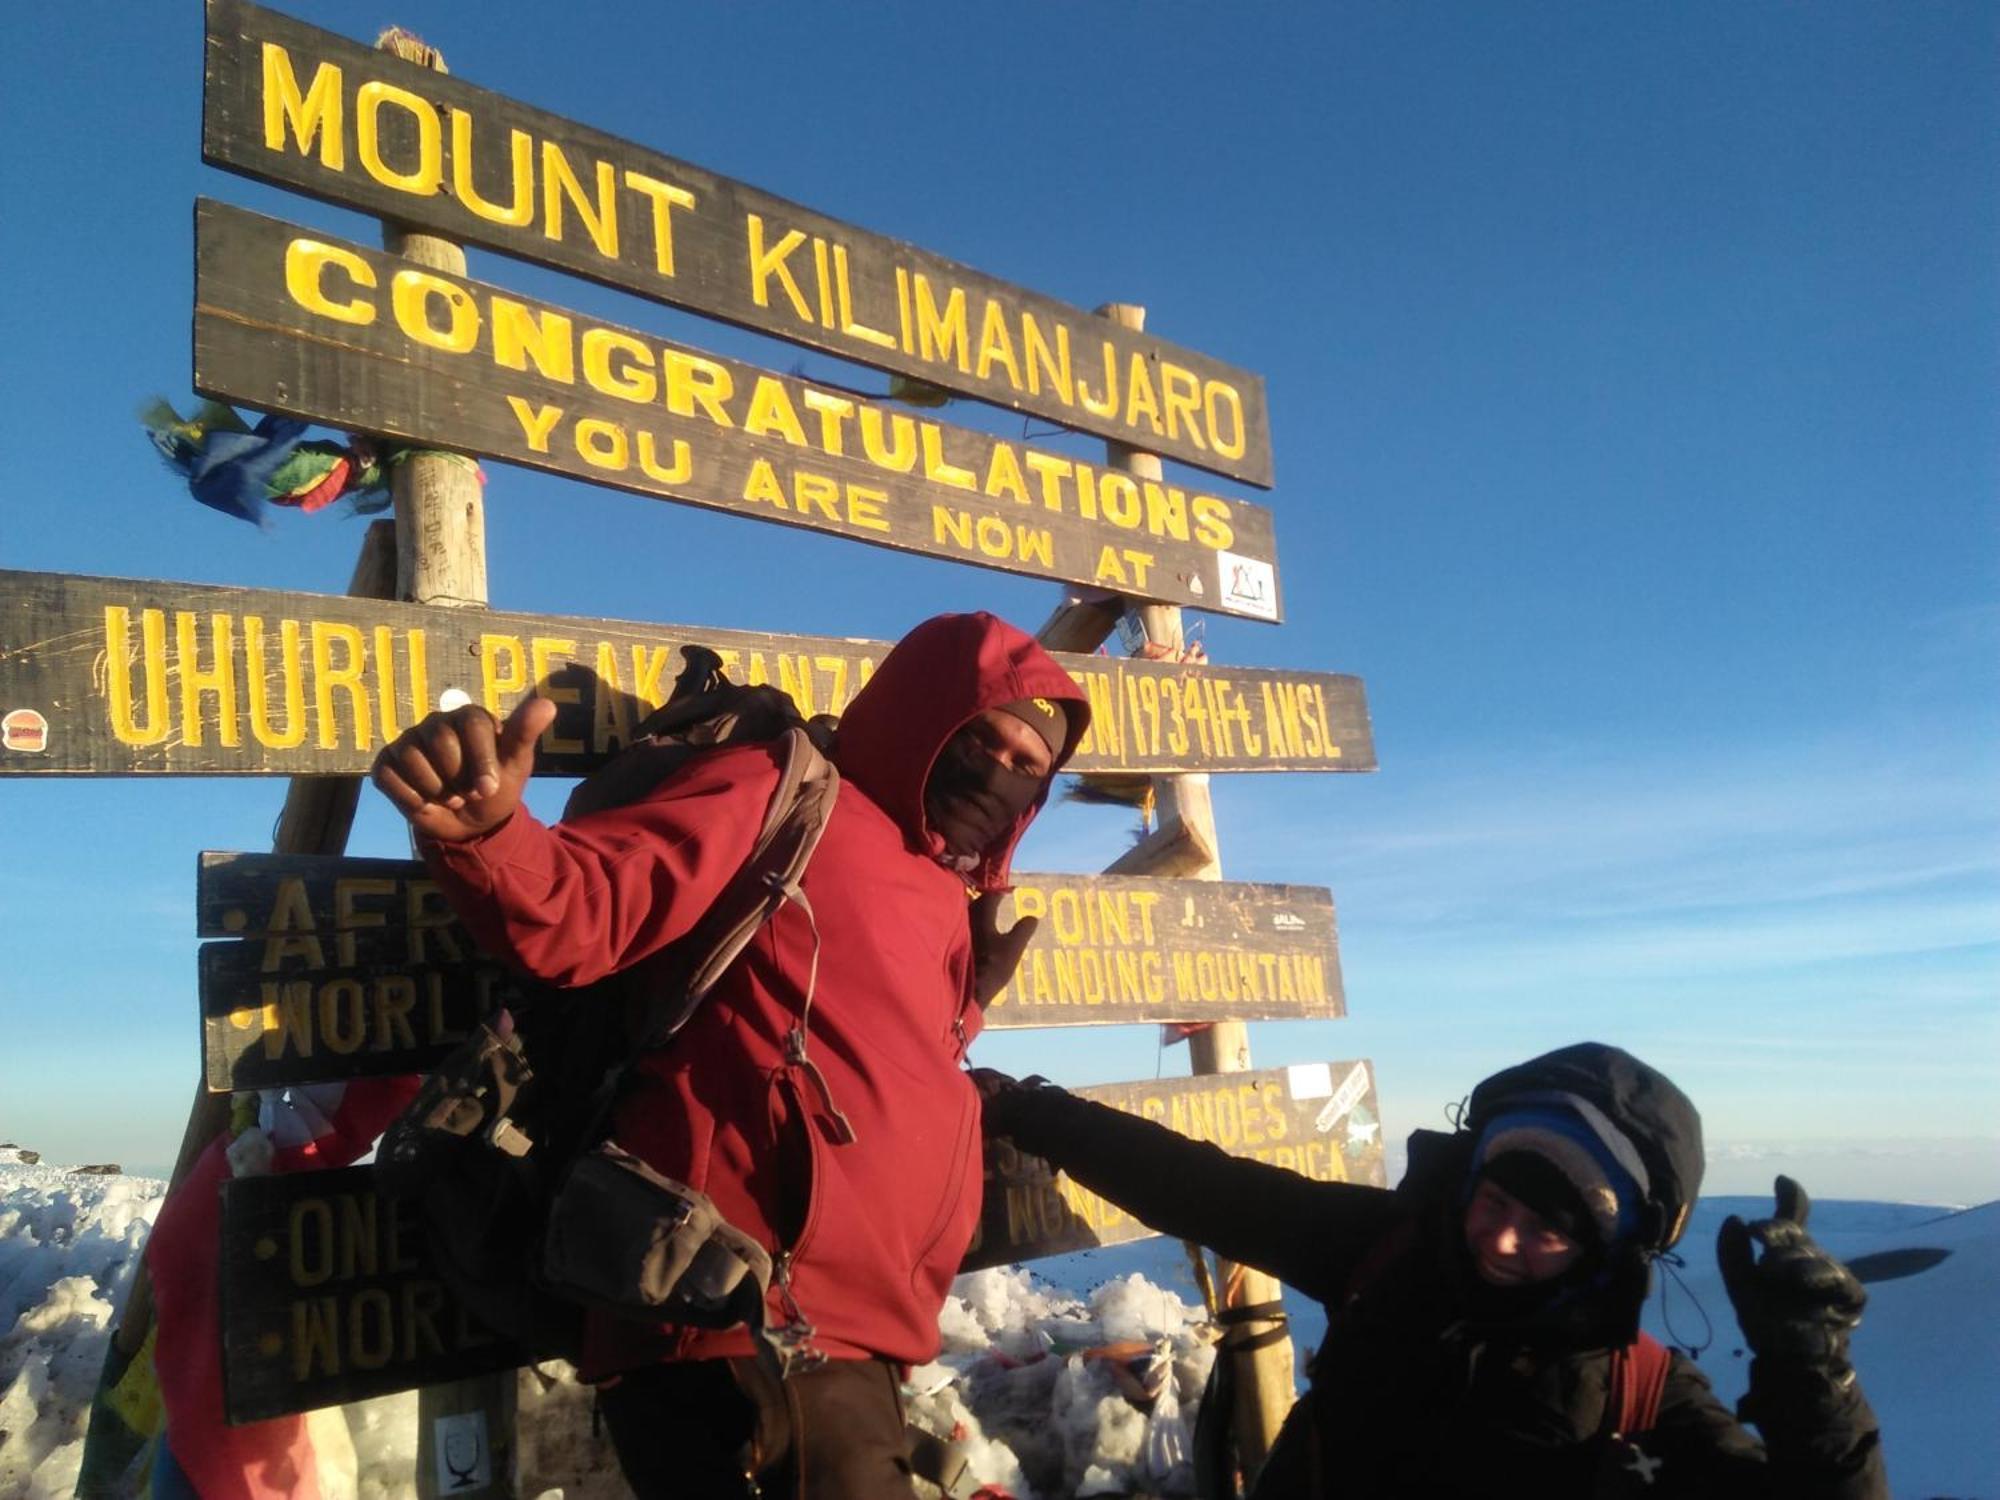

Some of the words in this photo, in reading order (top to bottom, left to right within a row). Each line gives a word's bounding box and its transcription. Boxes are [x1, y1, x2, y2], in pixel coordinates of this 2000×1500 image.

[262, 42, 696, 278] MOUNT
[747, 213, 1247, 461] KILIMANJARO
[285, 237, 1235, 552] CONGRATULATIONS
[506, 395, 692, 485] YOU
[743, 457, 892, 533] ARE
[932, 506, 1054, 569] NOW
[1096, 546, 1155, 589] AT
[105, 605, 430, 752] UHURU
[480, 633, 672, 755] PEAK
[1262, 681, 1342, 759] AMSL
[261, 874, 464, 974] AFR
[1013, 886, 1161, 946] POINT
[990, 947, 1163, 1007] TANDING
[1172, 950, 1329, 1004] MOUNTAIN
[288, 1190, 420, 1288] ONE
[290, 1279, 497, 1384] WORL
